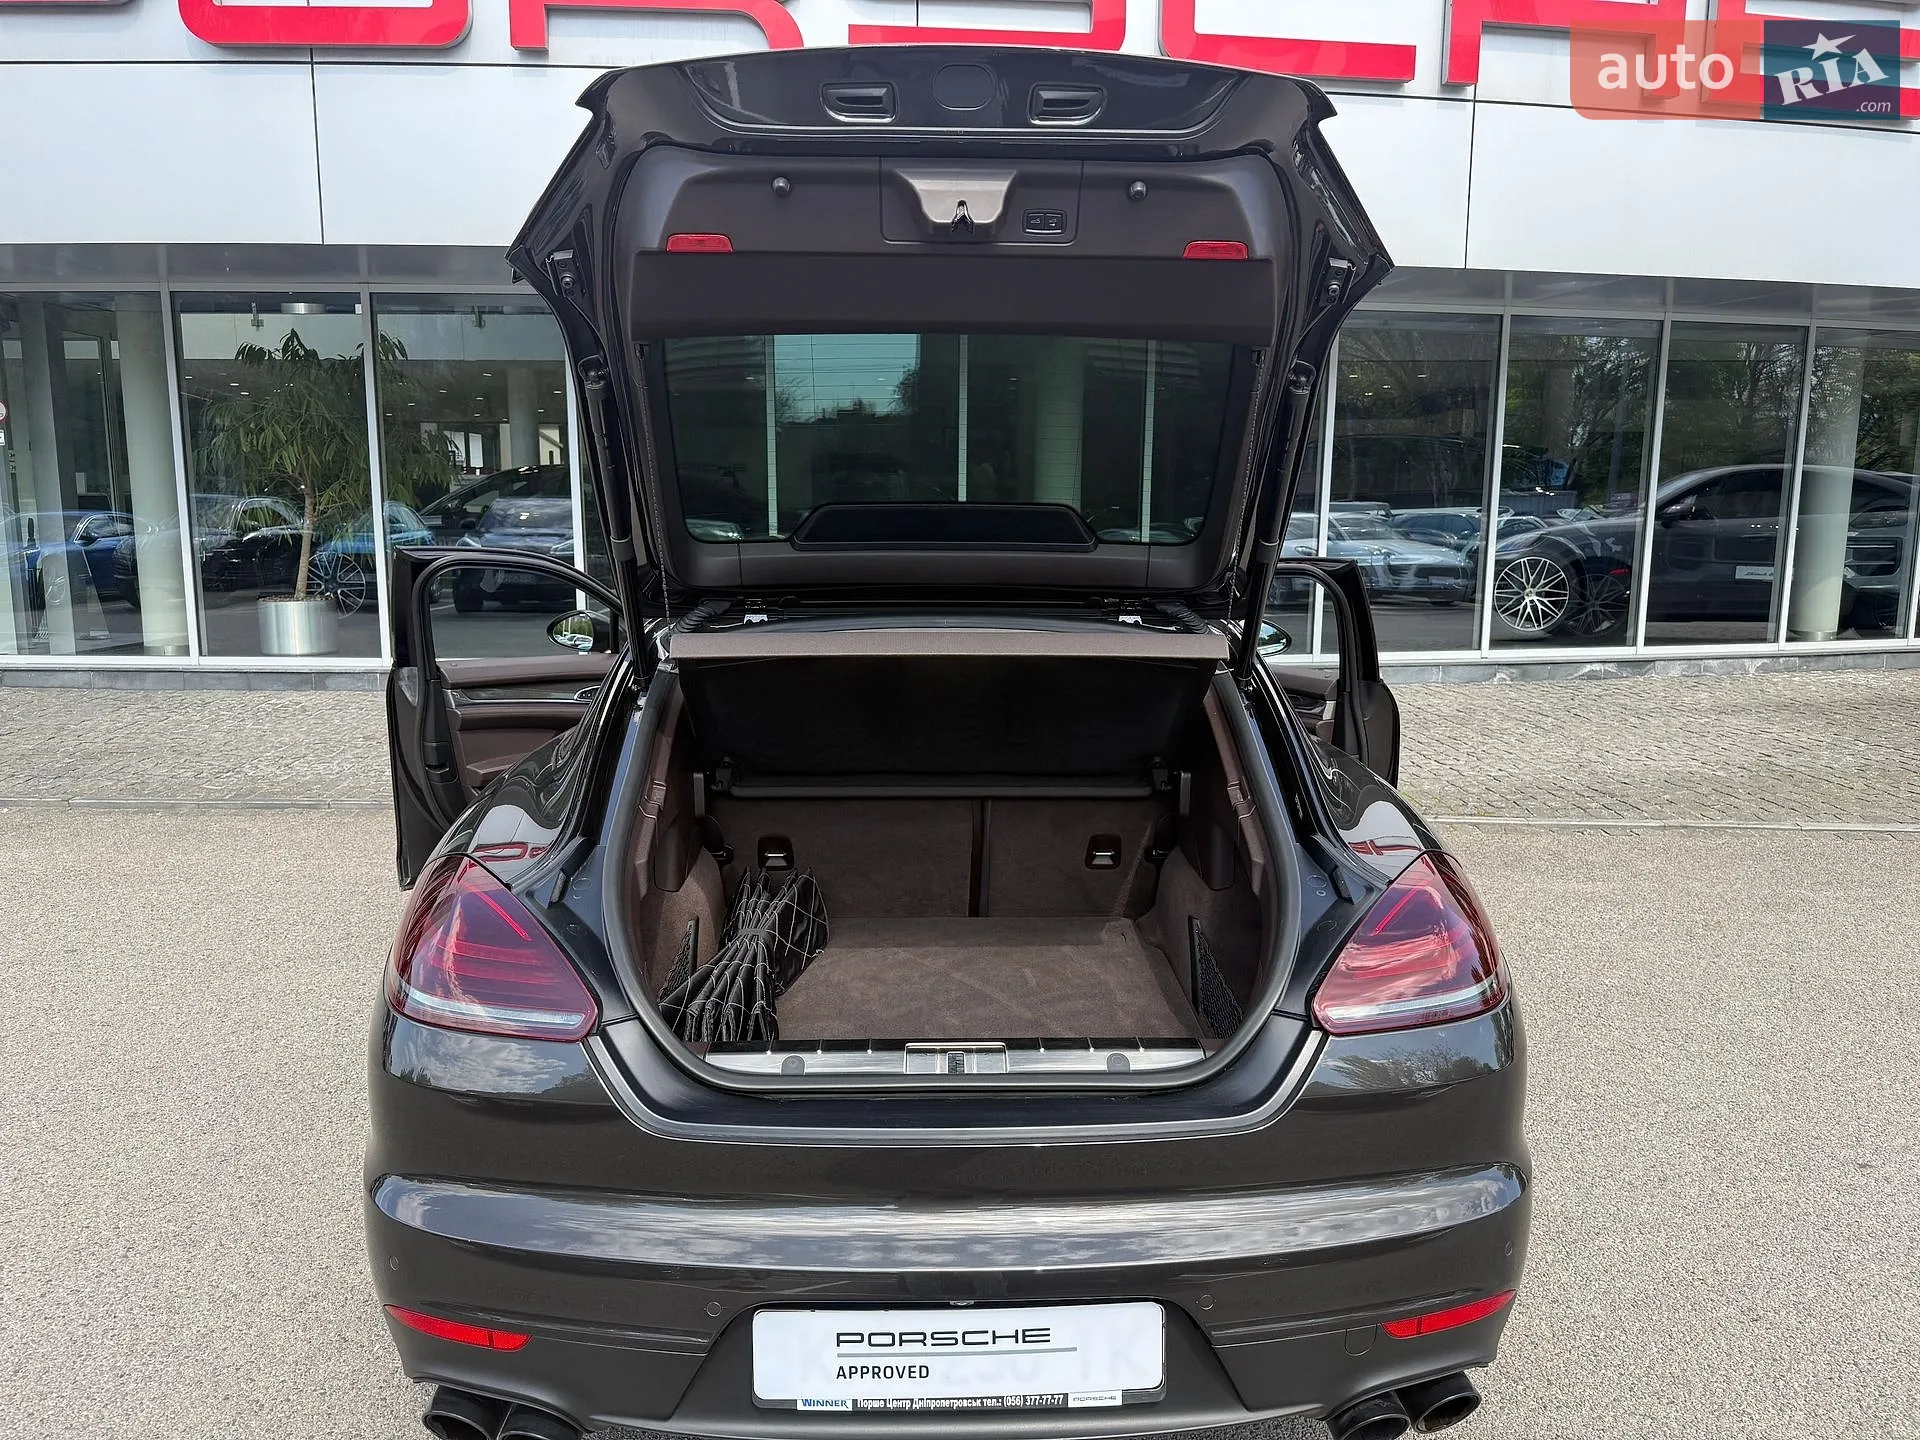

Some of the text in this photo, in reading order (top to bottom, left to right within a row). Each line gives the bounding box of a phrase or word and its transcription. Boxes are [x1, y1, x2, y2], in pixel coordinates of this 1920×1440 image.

[836, 1328, 1050, 1347] PORSCHE
[836, 1365, 930, 1380] APPROVED
[801, 1399, 849, 1409] WINNER
[886, 1399, 911, 1410] Центр
[1003, 1395, 1024, 1407] (056)
[1025, 1394, 1064, 1406] 377-77-77
